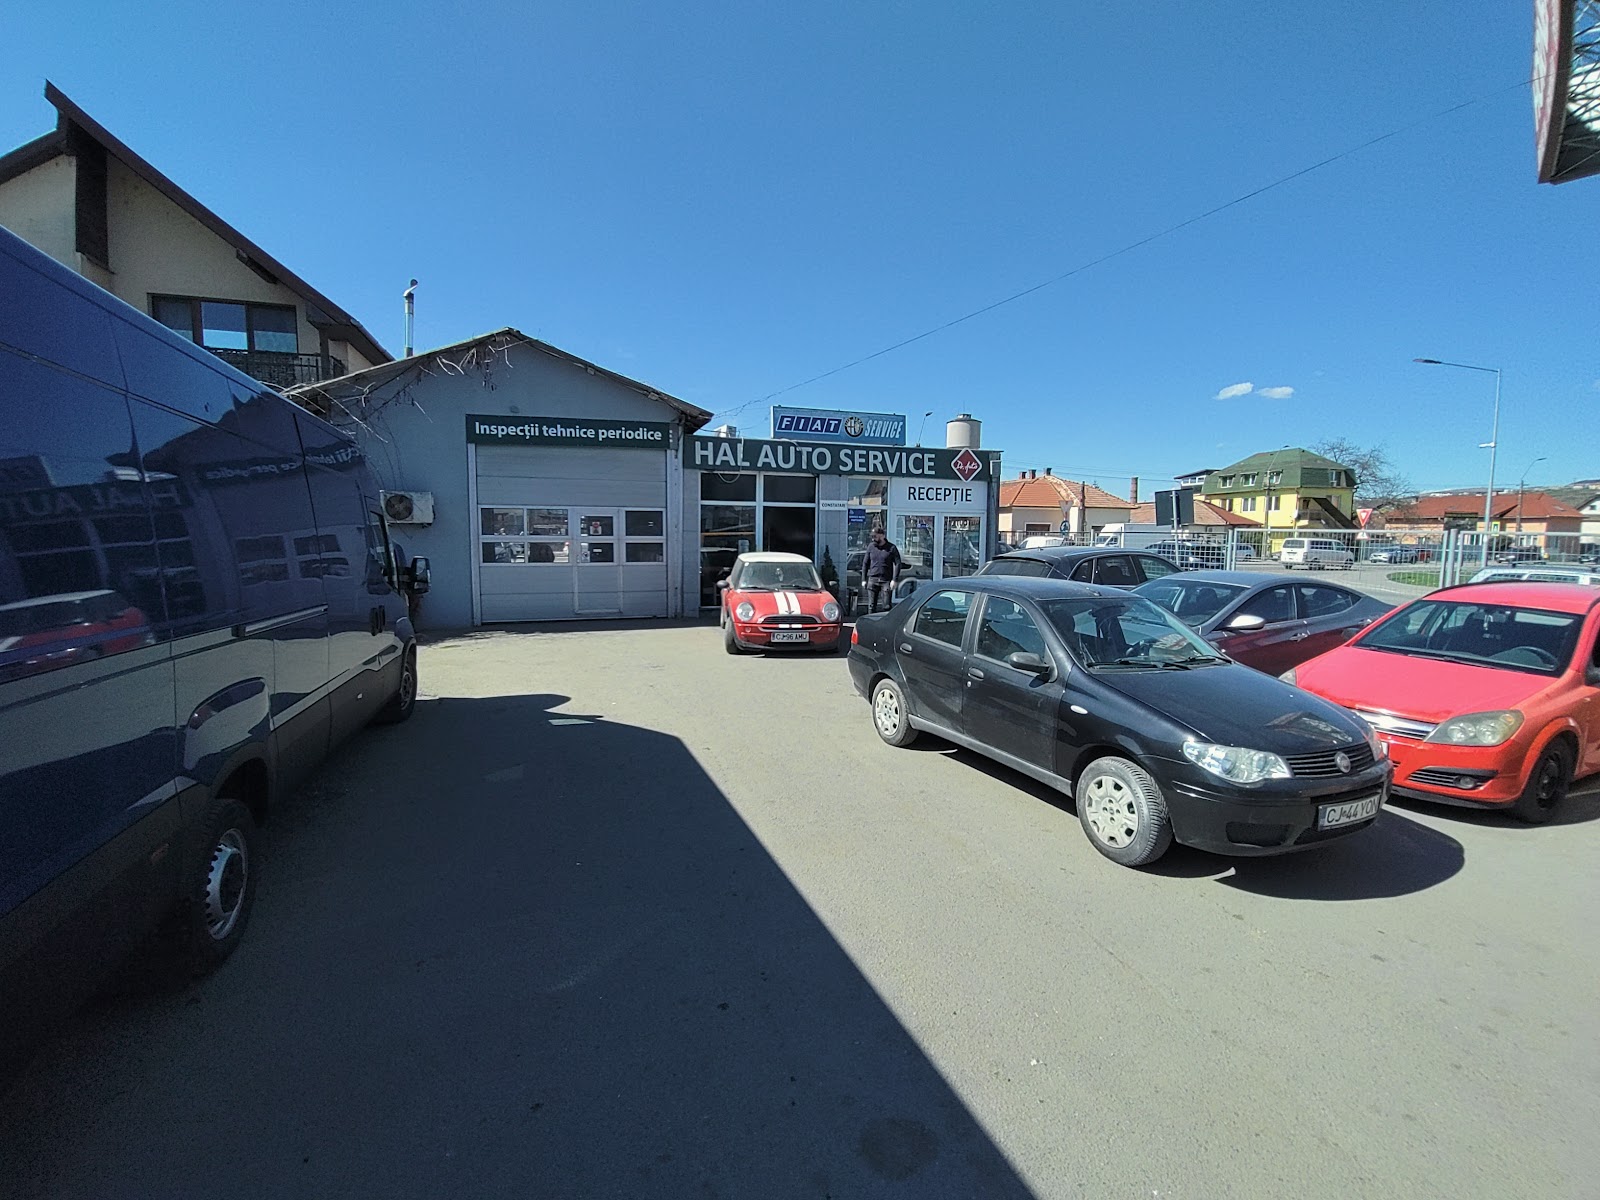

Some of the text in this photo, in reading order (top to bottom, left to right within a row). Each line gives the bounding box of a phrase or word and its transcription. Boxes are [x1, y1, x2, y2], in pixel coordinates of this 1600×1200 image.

[475, 421, 662, 441] Inspecții tehnice periodice
[780, 416, 840, 433] FIAT
[865, 419, 903, 438] SERVICE
[694, 441, 935, 475] HAL AUTO SERVICE
[908, 486, 972, 505] RECEPȚIE
[1326, 797, 1379, 824] CJ 44 YON
